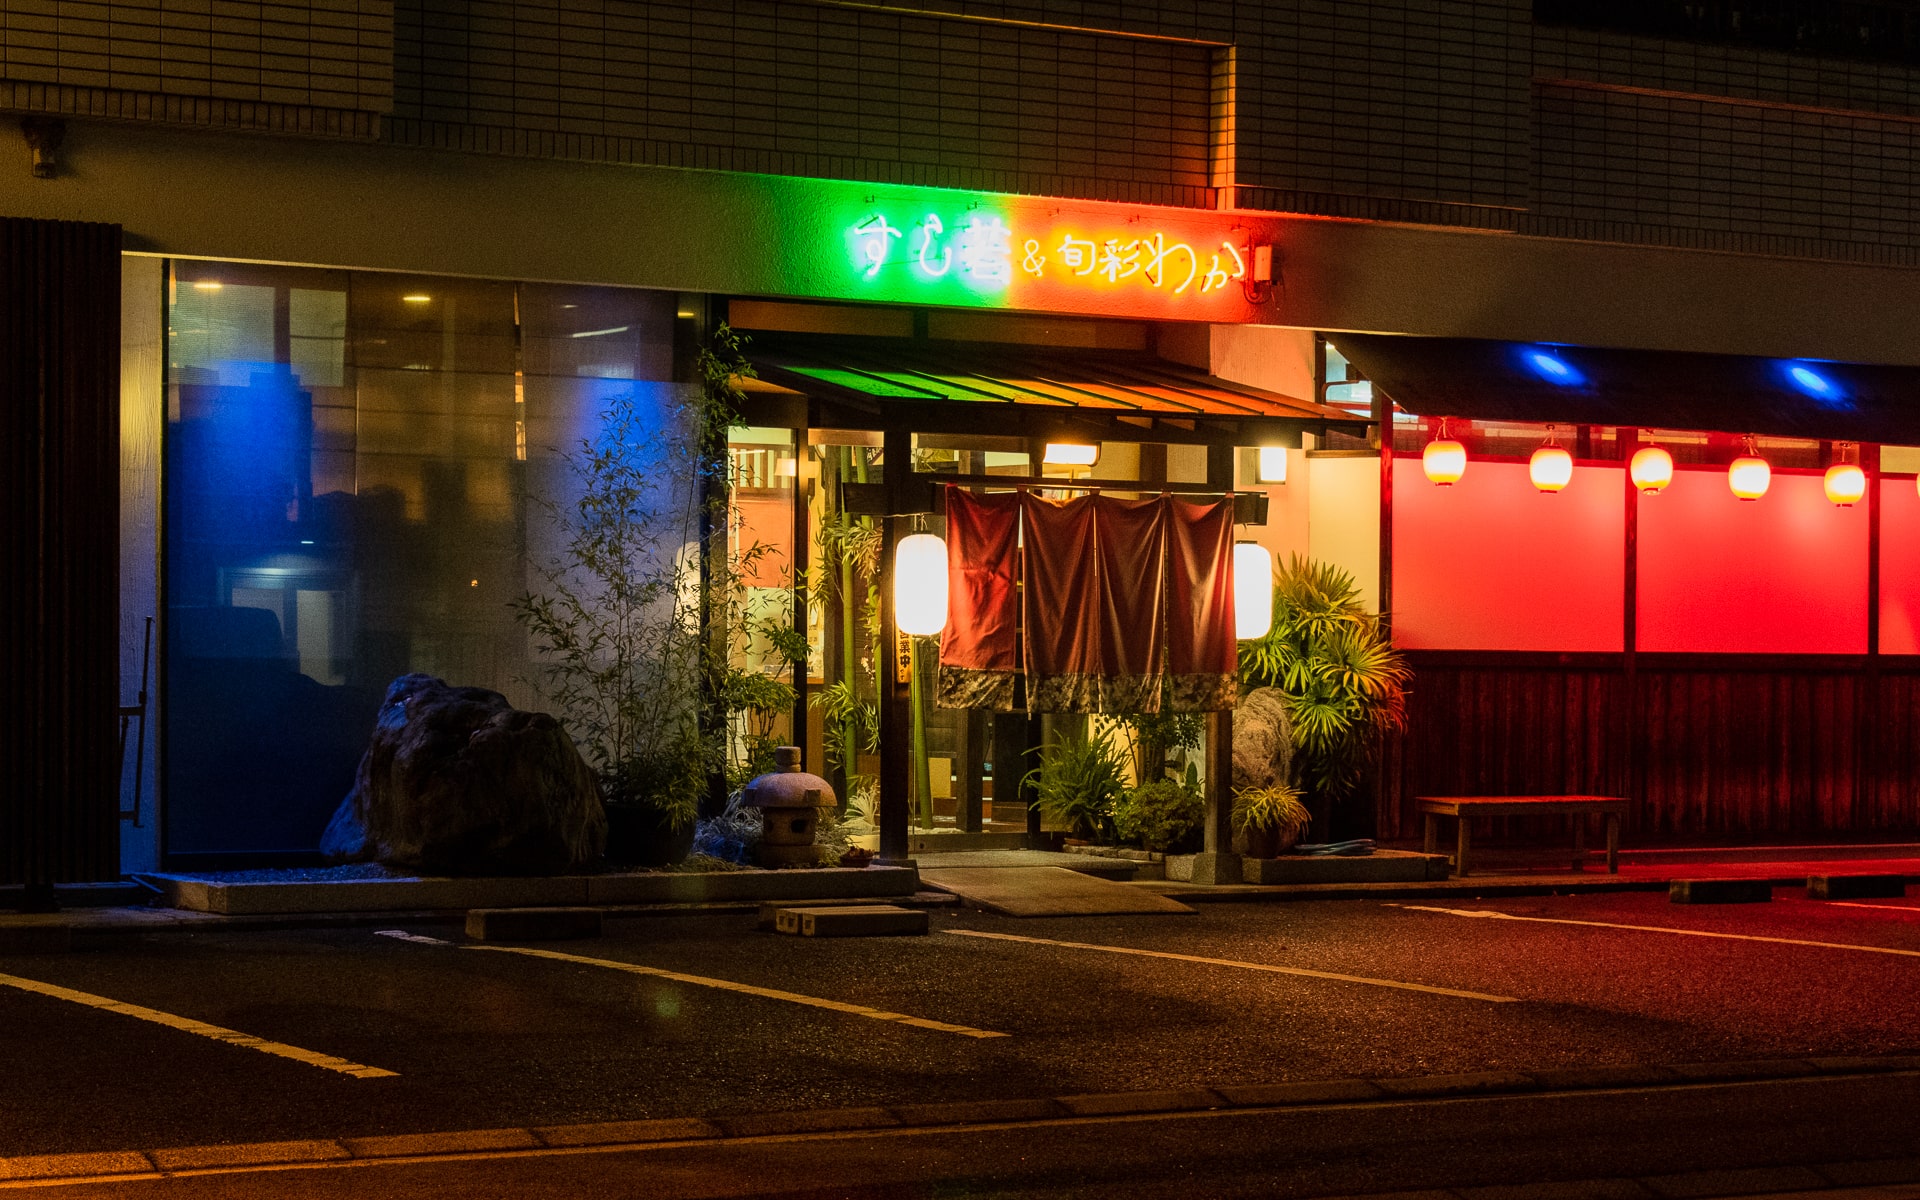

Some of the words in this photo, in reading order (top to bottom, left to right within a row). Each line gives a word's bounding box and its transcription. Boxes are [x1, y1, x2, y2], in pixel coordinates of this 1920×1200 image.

[1024, 239, 1045, 277] &
[1058, 232, 1245, 294] 旬彩わか
